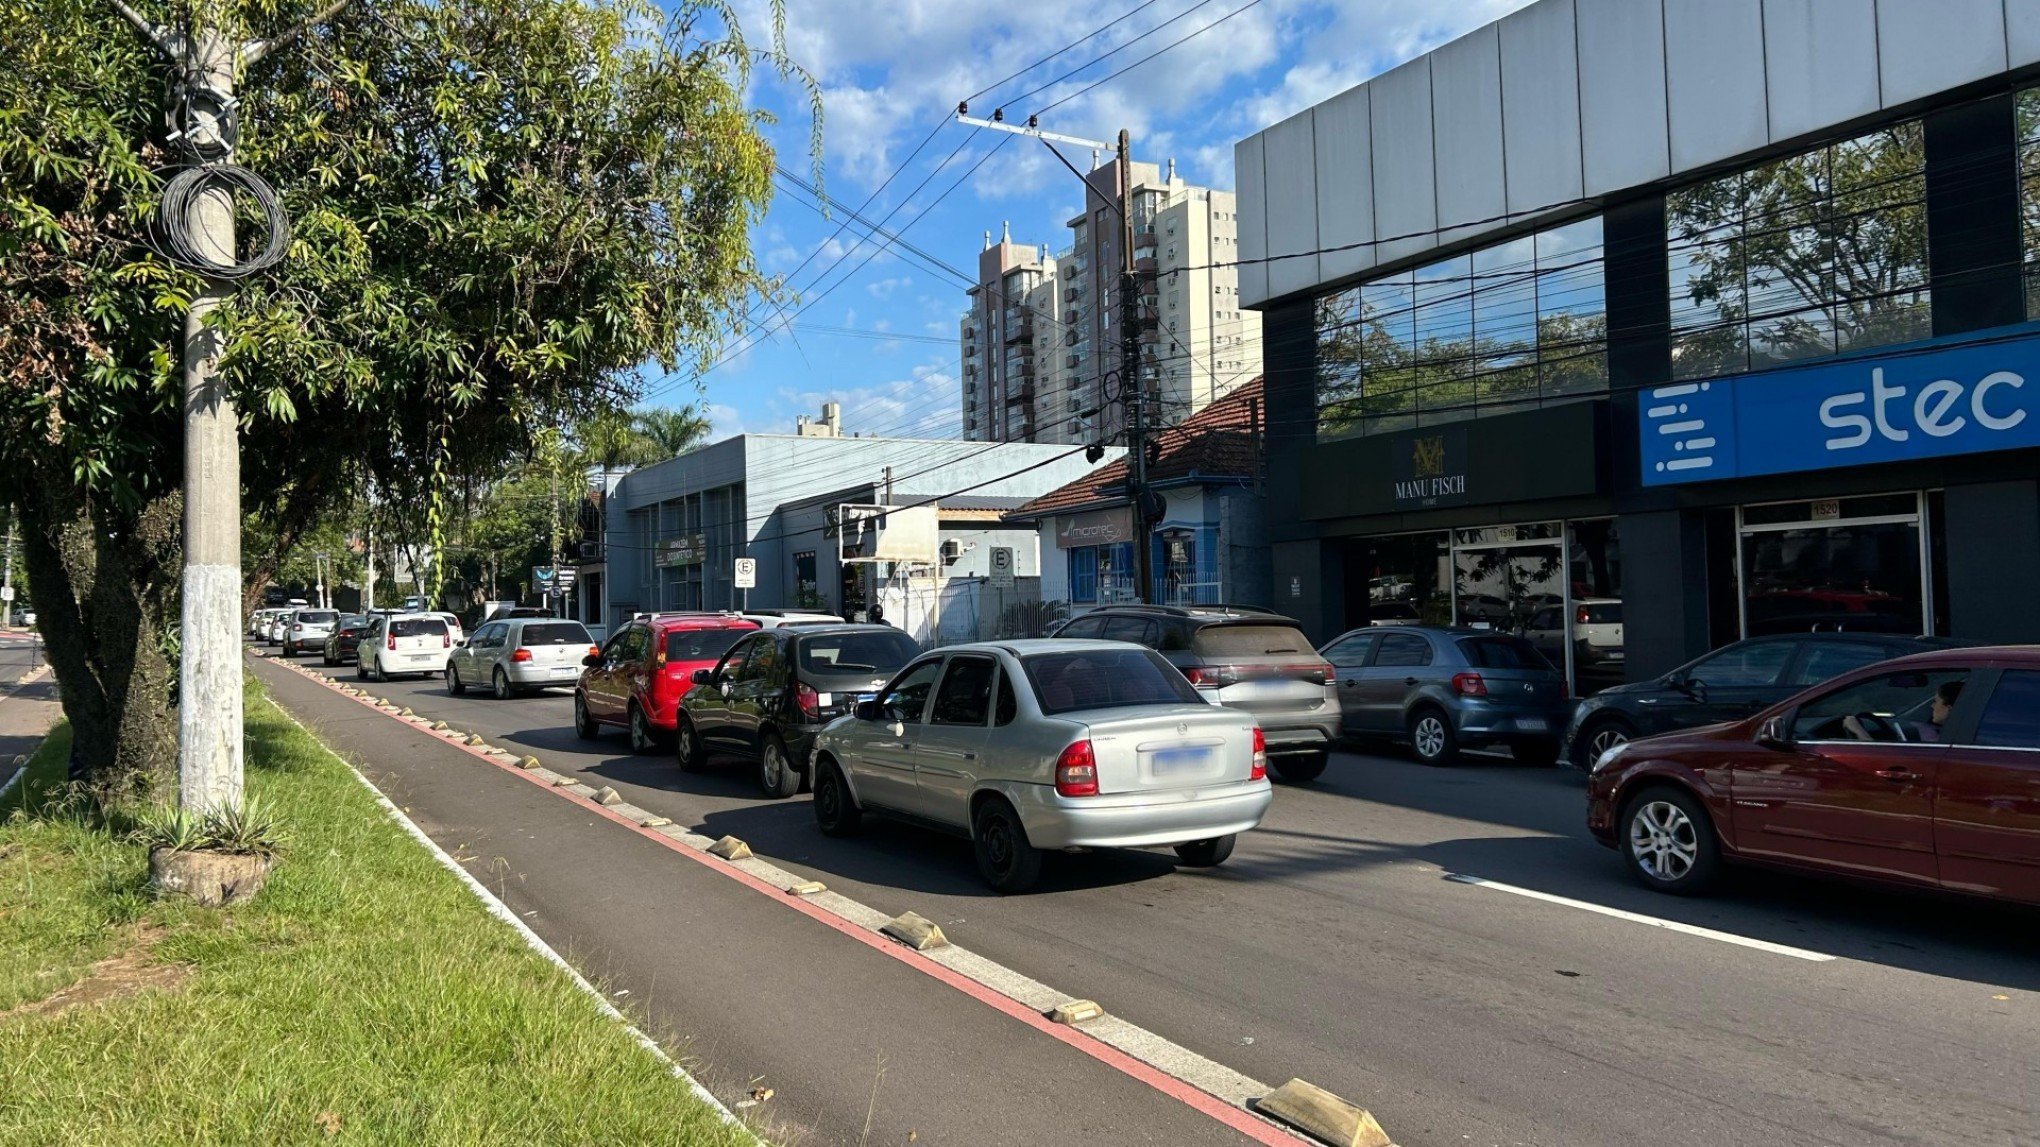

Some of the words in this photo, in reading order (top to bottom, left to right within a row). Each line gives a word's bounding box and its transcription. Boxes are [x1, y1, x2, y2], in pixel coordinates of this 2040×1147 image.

[1818, 366, 2027, 450] stec
[1395, 479, 1428, 499] MANU
[1432, 475, 1465, 496] FISCH
[1814, 503, 1838, 515] 1520
[1499, 528, 1515, 538] 1510
[996, 551, 1005, 566] E
[742, 562, 749, 572] E
